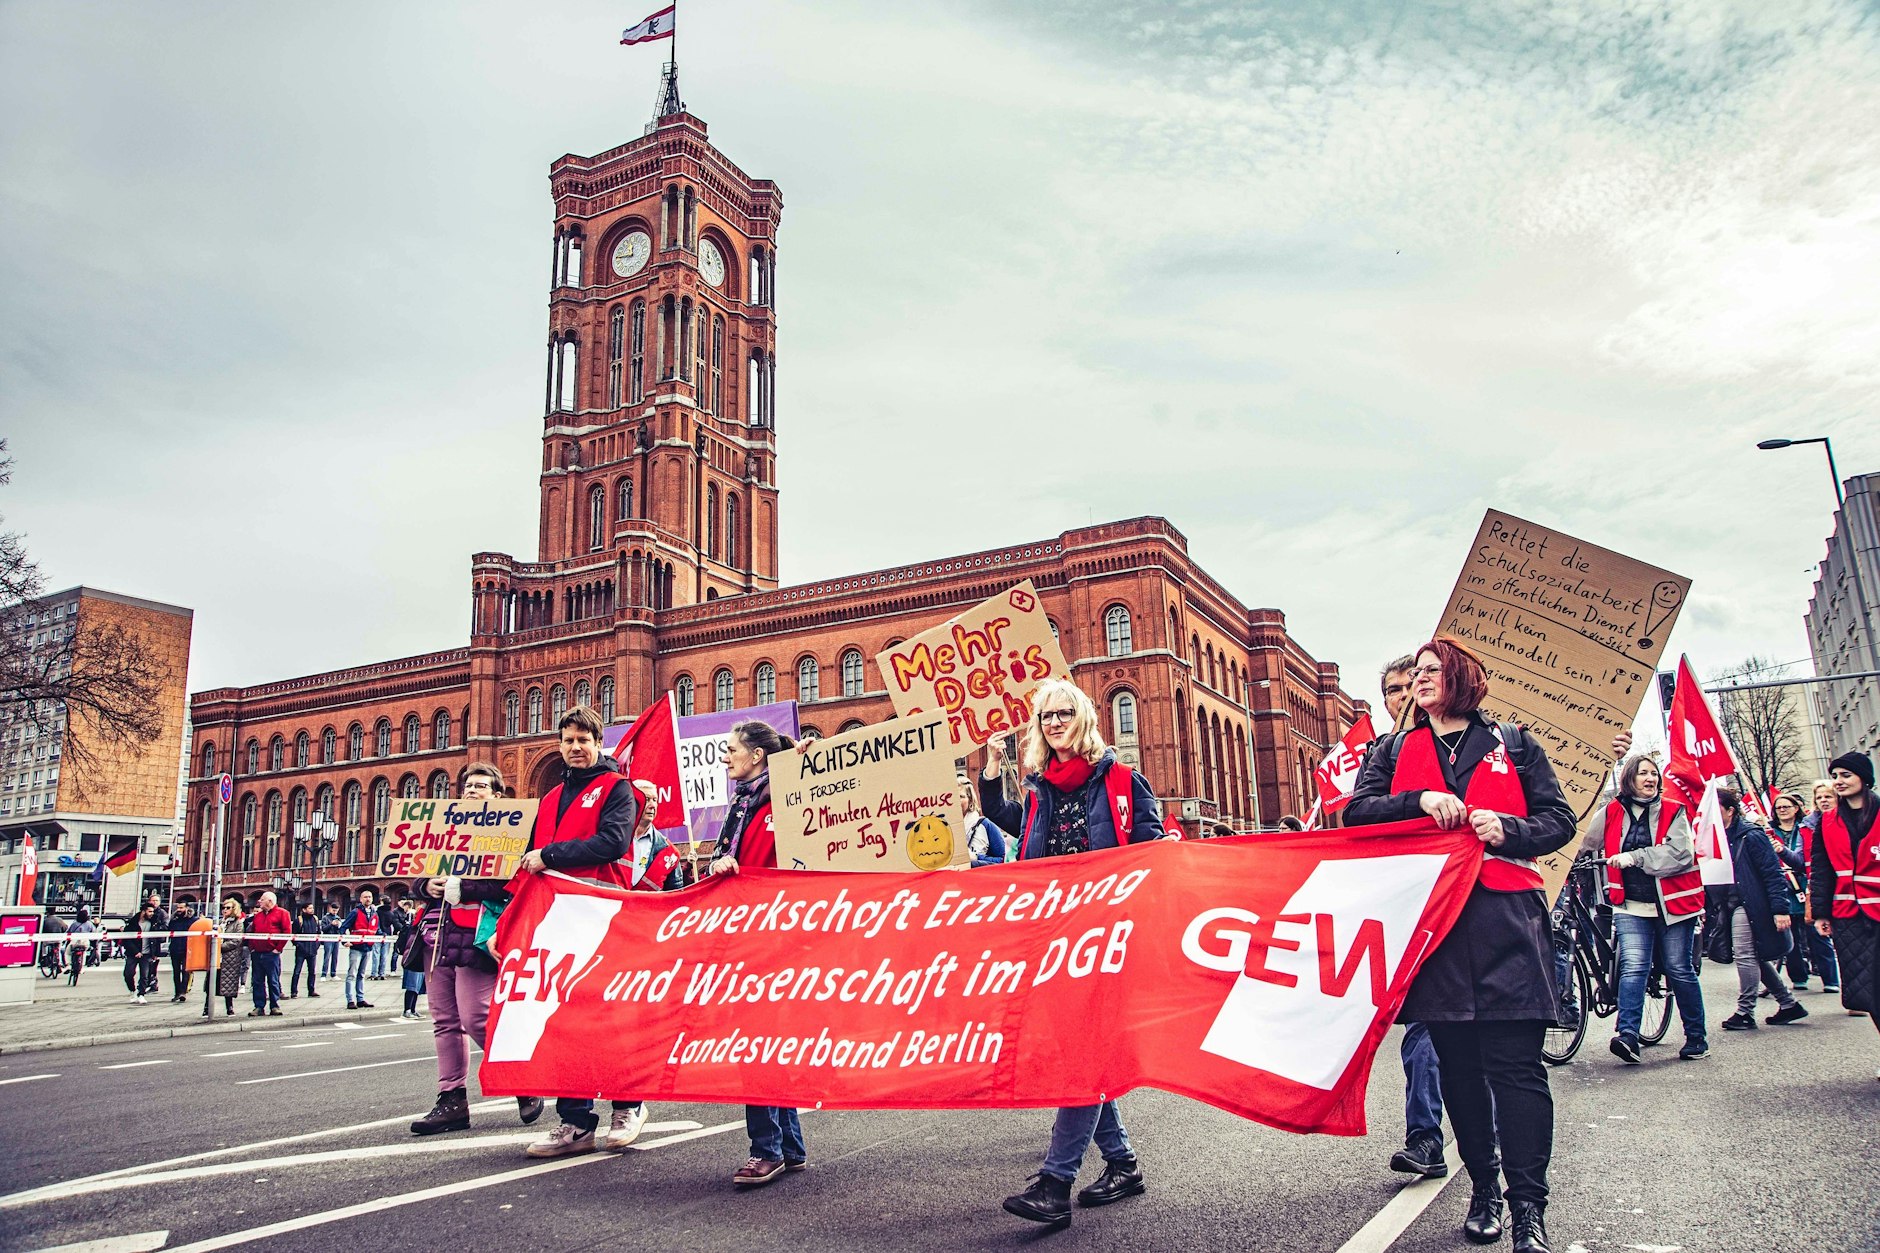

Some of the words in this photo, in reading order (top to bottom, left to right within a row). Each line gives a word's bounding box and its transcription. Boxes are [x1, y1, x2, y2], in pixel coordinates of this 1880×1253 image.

[1488, 520, 1548, 559] Rettet
[1561, 546, 1590, 573] die
[1467, 570, 1486, 585] im
[1492, 577, 1577, 619] öffentlichen
[1583, 604, 1637, 638] Dienst
[1477, 545, 1645, 615] Schulsozialarbeit
[1446, 618, 1558, 668] Auslaufmodell
[1478, 608, 1510, 627] will
[1514, 615, 1548, 640] kein
[890, 617, 1011, 692] Mehr
[933, 645, 1052, 714] Defis
[800, 720, 943, 780] ACHTSAMKEIT
[1547, 755, 1602, 783] rauchen
[1583, 746, 1612, 769] Jahre
[785, 791, 802, 807] ICH
[809, 778, 862, 802] FORDERE:
[1563, 779, 1588, 794] für
[388, 822, 472, 852] Schutz
[473, 831, 529, 853] meiner
[400, 801, 436, 821] ICH
[443, 801, 523, 827] fordere
[802, 807, 819, 837] 2
[819, 800, 871, 829] Minuten
[876, 792, 954, 819] Atempause
[381, 853, 520, 877] GESUNDHEIT
[827, 838, 848, 861] pro
[656, 888, 920, 943] Gewerkschaft
[923, 868, 1151, 930] Erziehung
[494, 947, 604, 1004] GEW
[603, 958, 684, 1004] und
[682, 950, 959, 1015] Wissenschaft
[962, 949, 1028, 997] im
[1032, 919, 1135, 988] DGB
[1180, 906, 1434, 1010] GEW
[667, 1027, 903, 1069] Landesverband
[900, 1021, 1005, 1068] Berlin
